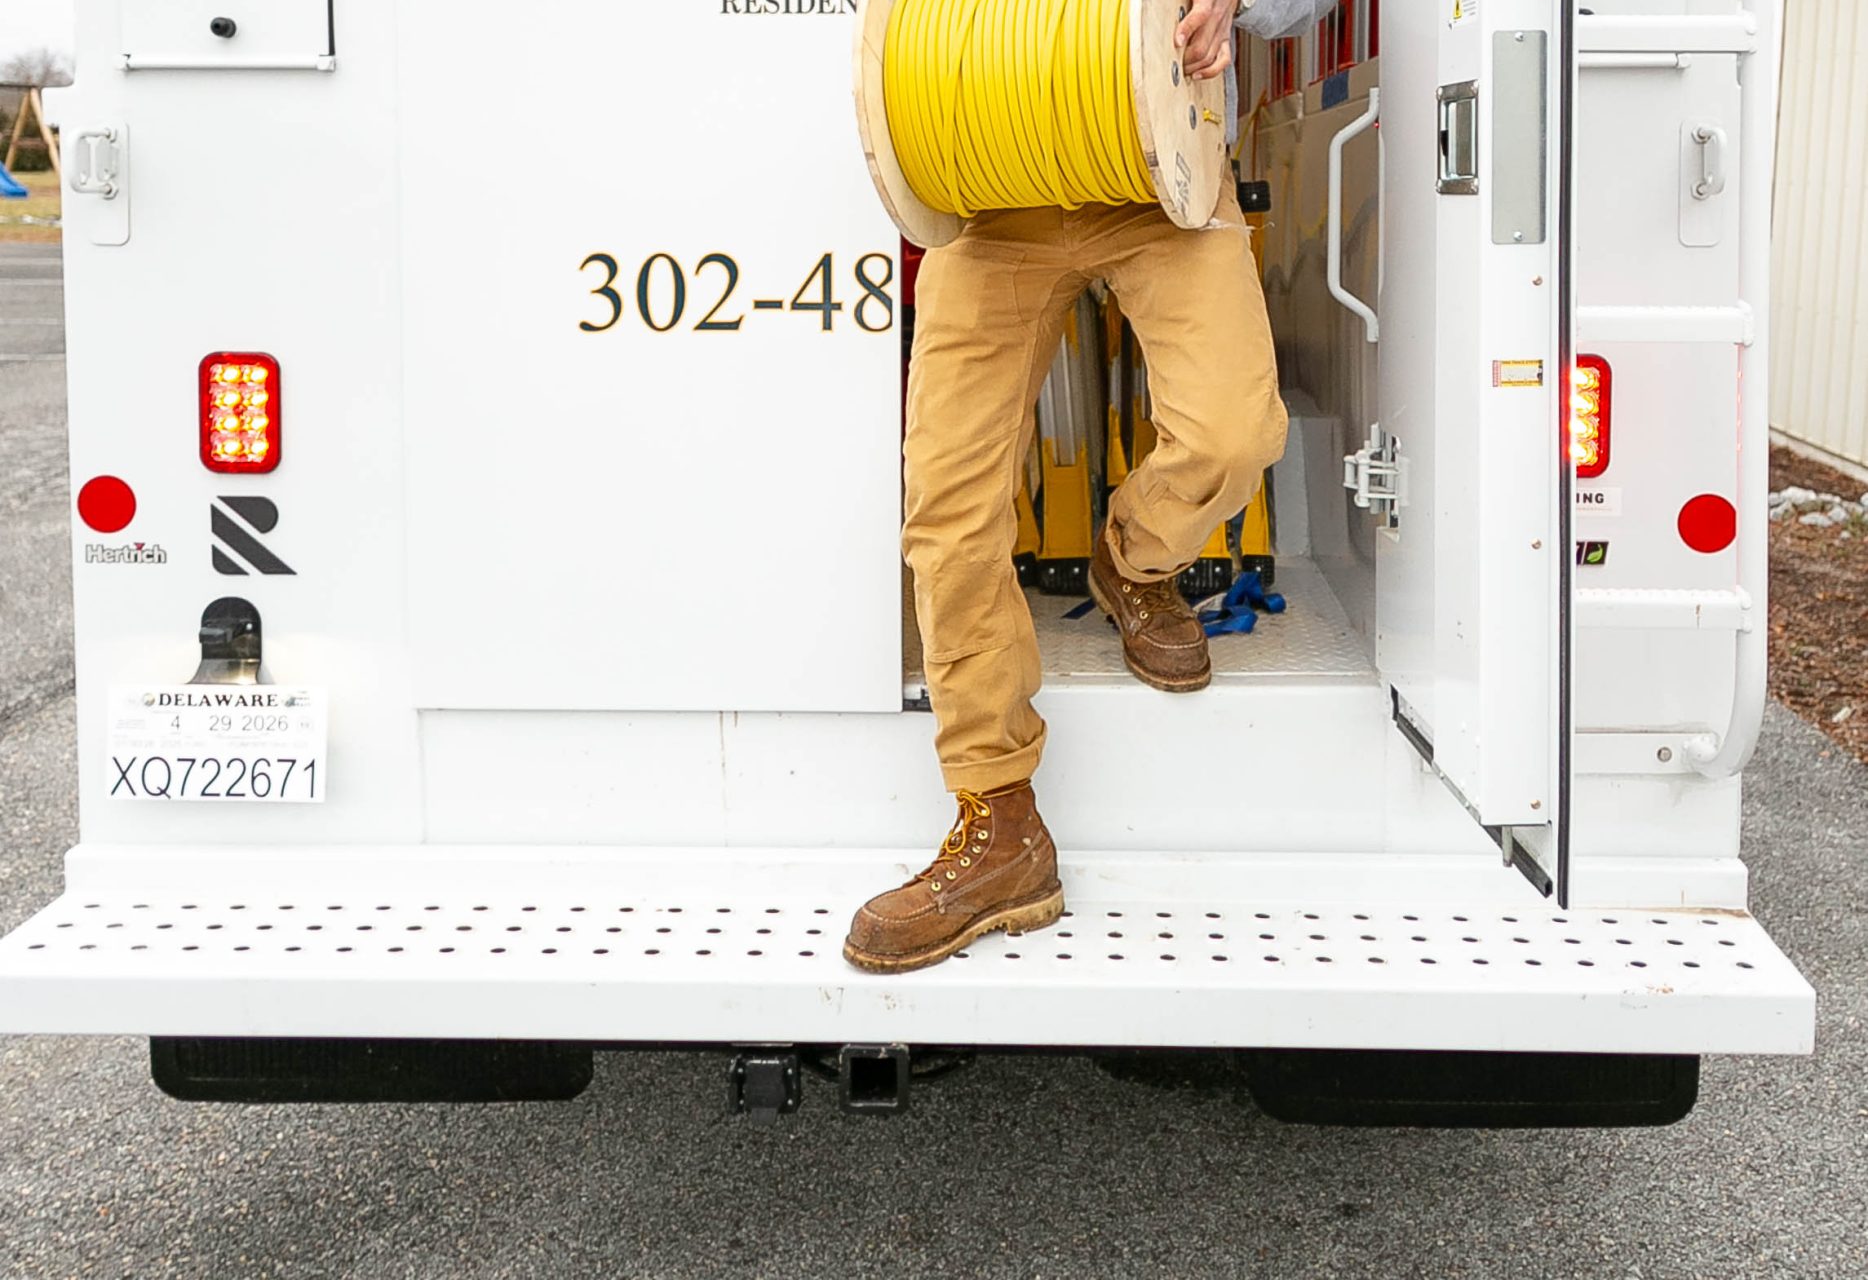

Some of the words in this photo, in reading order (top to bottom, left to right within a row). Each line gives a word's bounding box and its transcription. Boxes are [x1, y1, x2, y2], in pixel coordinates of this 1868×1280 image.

[578, 252, 893, 333] 302-48
[85, 542, 167, 564] Hertrich
[158, 693, 279, 707] DELAWARE
[170, 714, 180, 731] 4
[208, 715, 232, 731] 29
[241, 715, 289, 732] 2026
[110, 756, 315, 800] XQ722671
